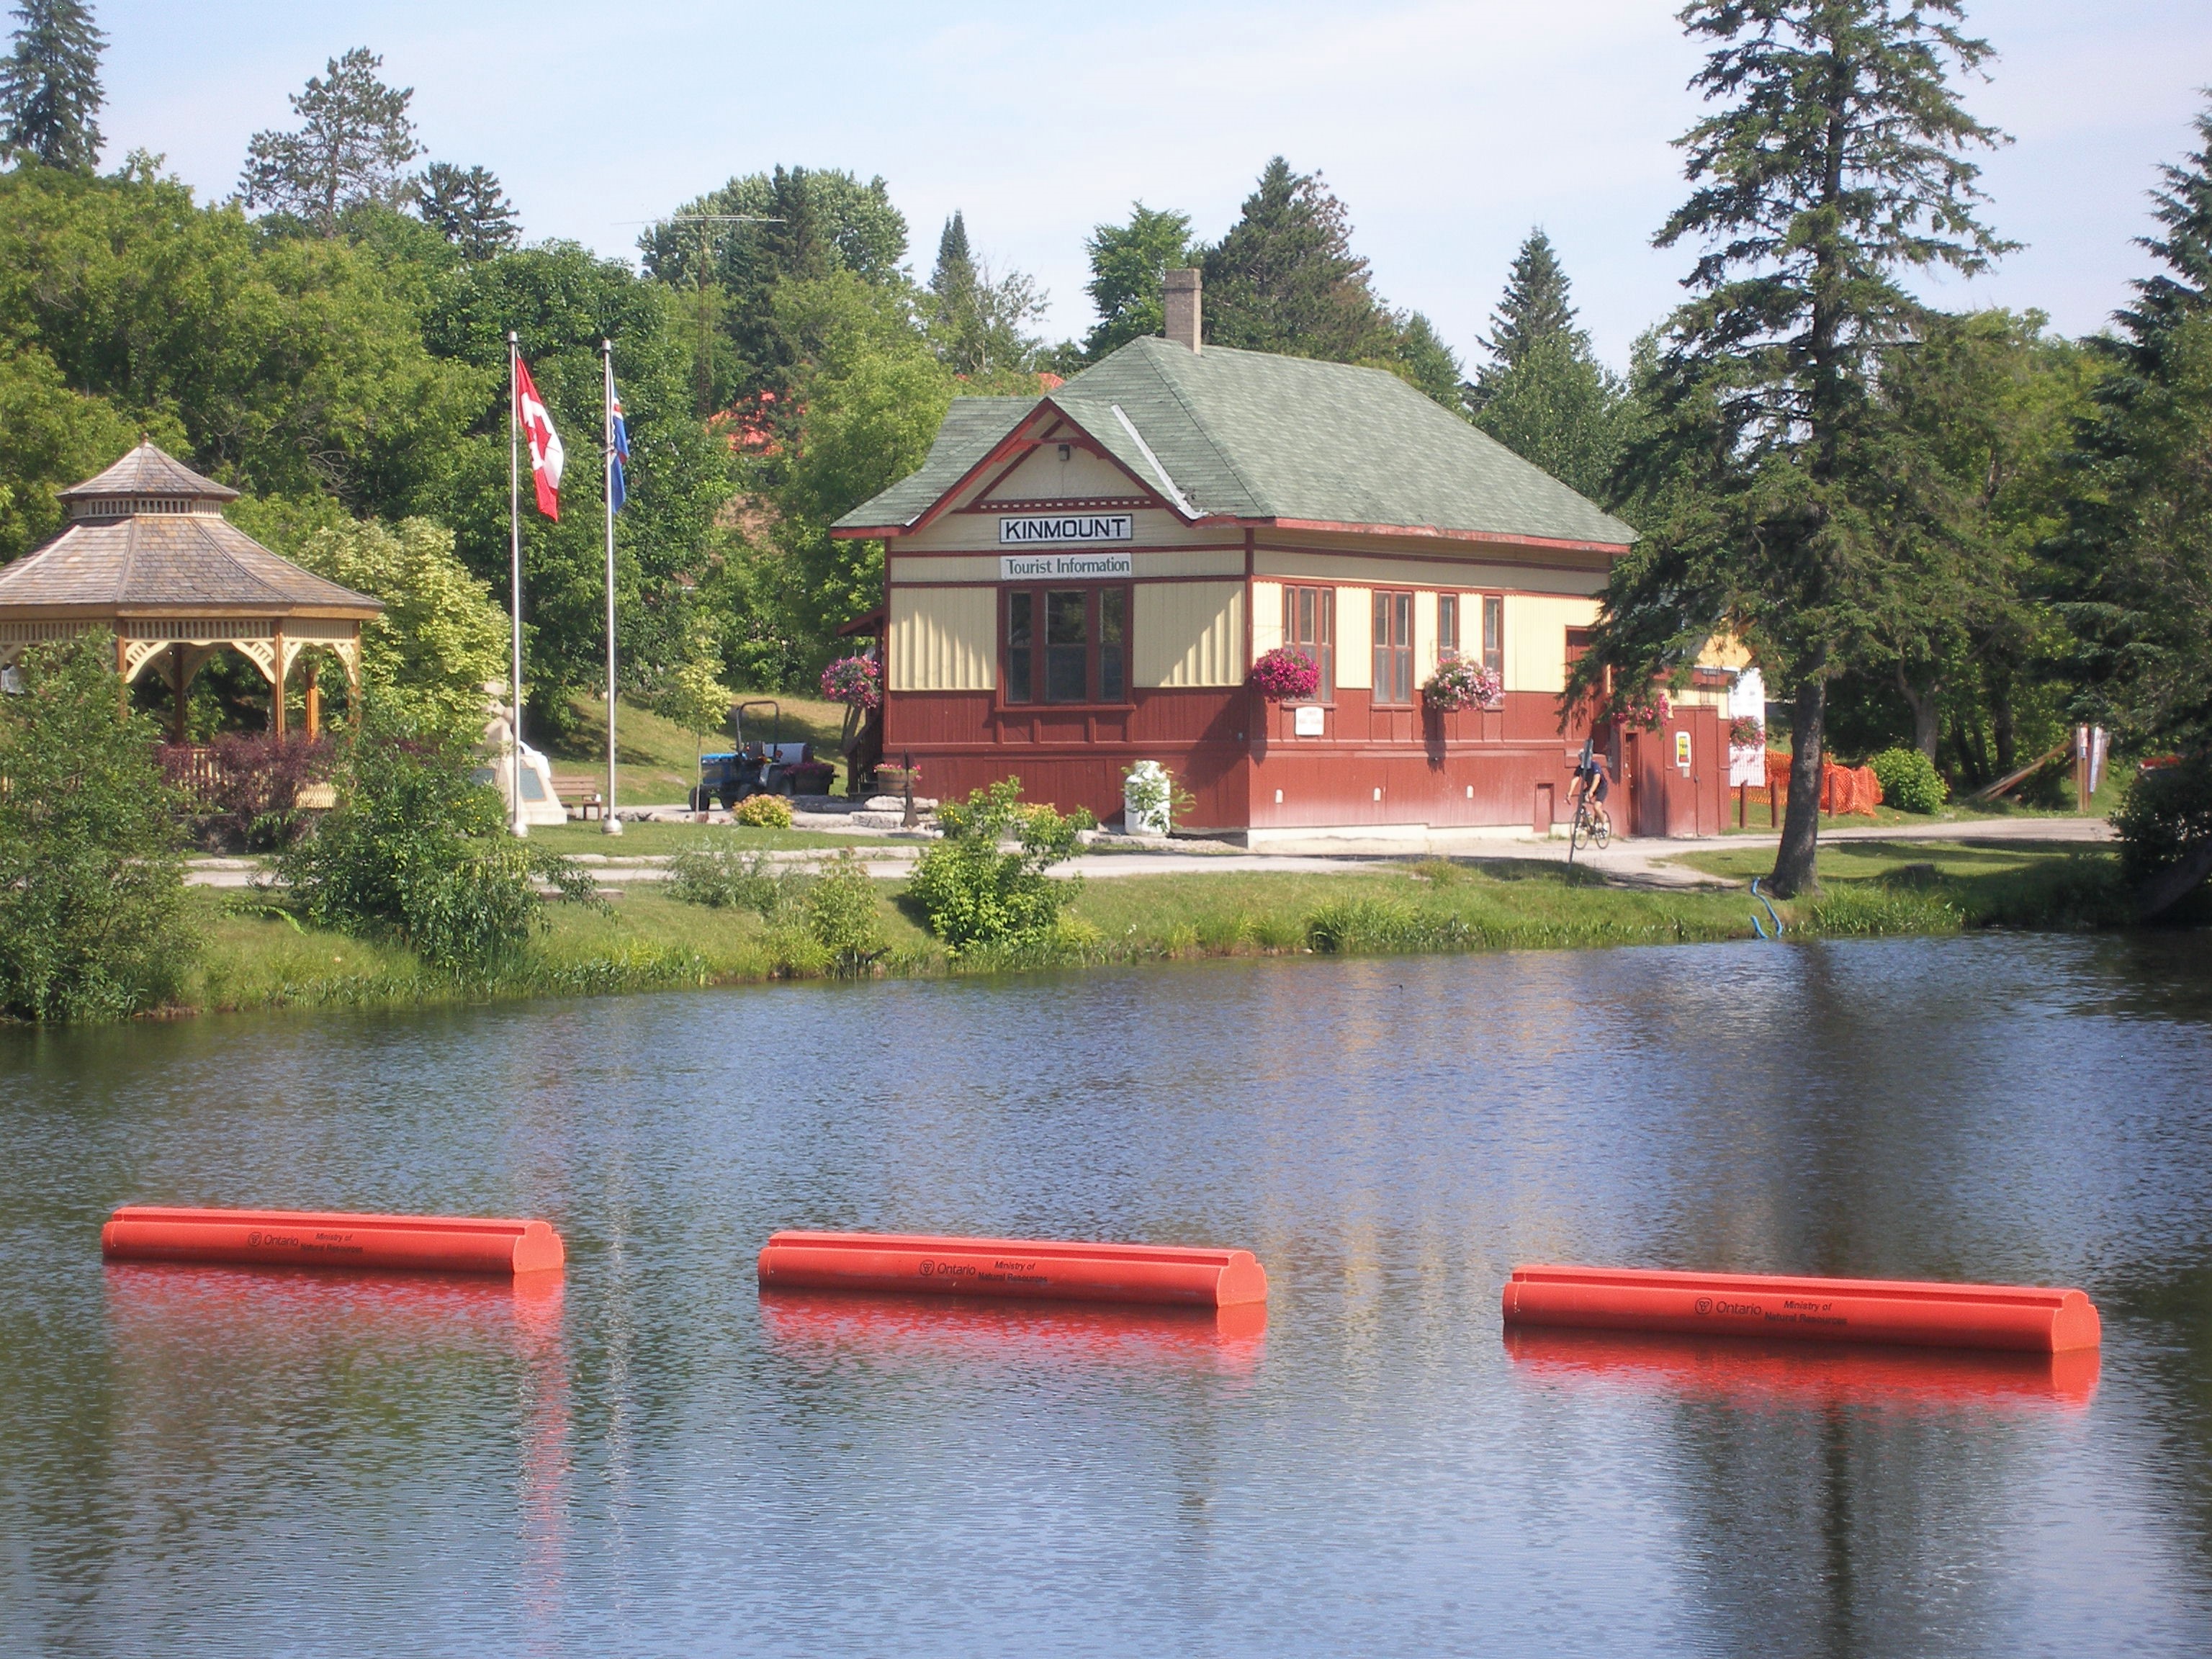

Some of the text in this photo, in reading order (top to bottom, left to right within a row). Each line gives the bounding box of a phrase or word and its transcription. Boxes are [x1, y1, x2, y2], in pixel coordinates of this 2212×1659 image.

[1006, 518, 1126, 539] KINMOUNT
[1006, 557, 1129, 575] Tourist Information
[264, 1234, 299, 1246] Ontario
[938, 1262, 976, 1276] Ontario
[994, 1261, 1025, 1272] Ministry
[1716, 1300, 1761, 1316] Ontario
[1784, 1300, 1833, 1311] Ministry of
